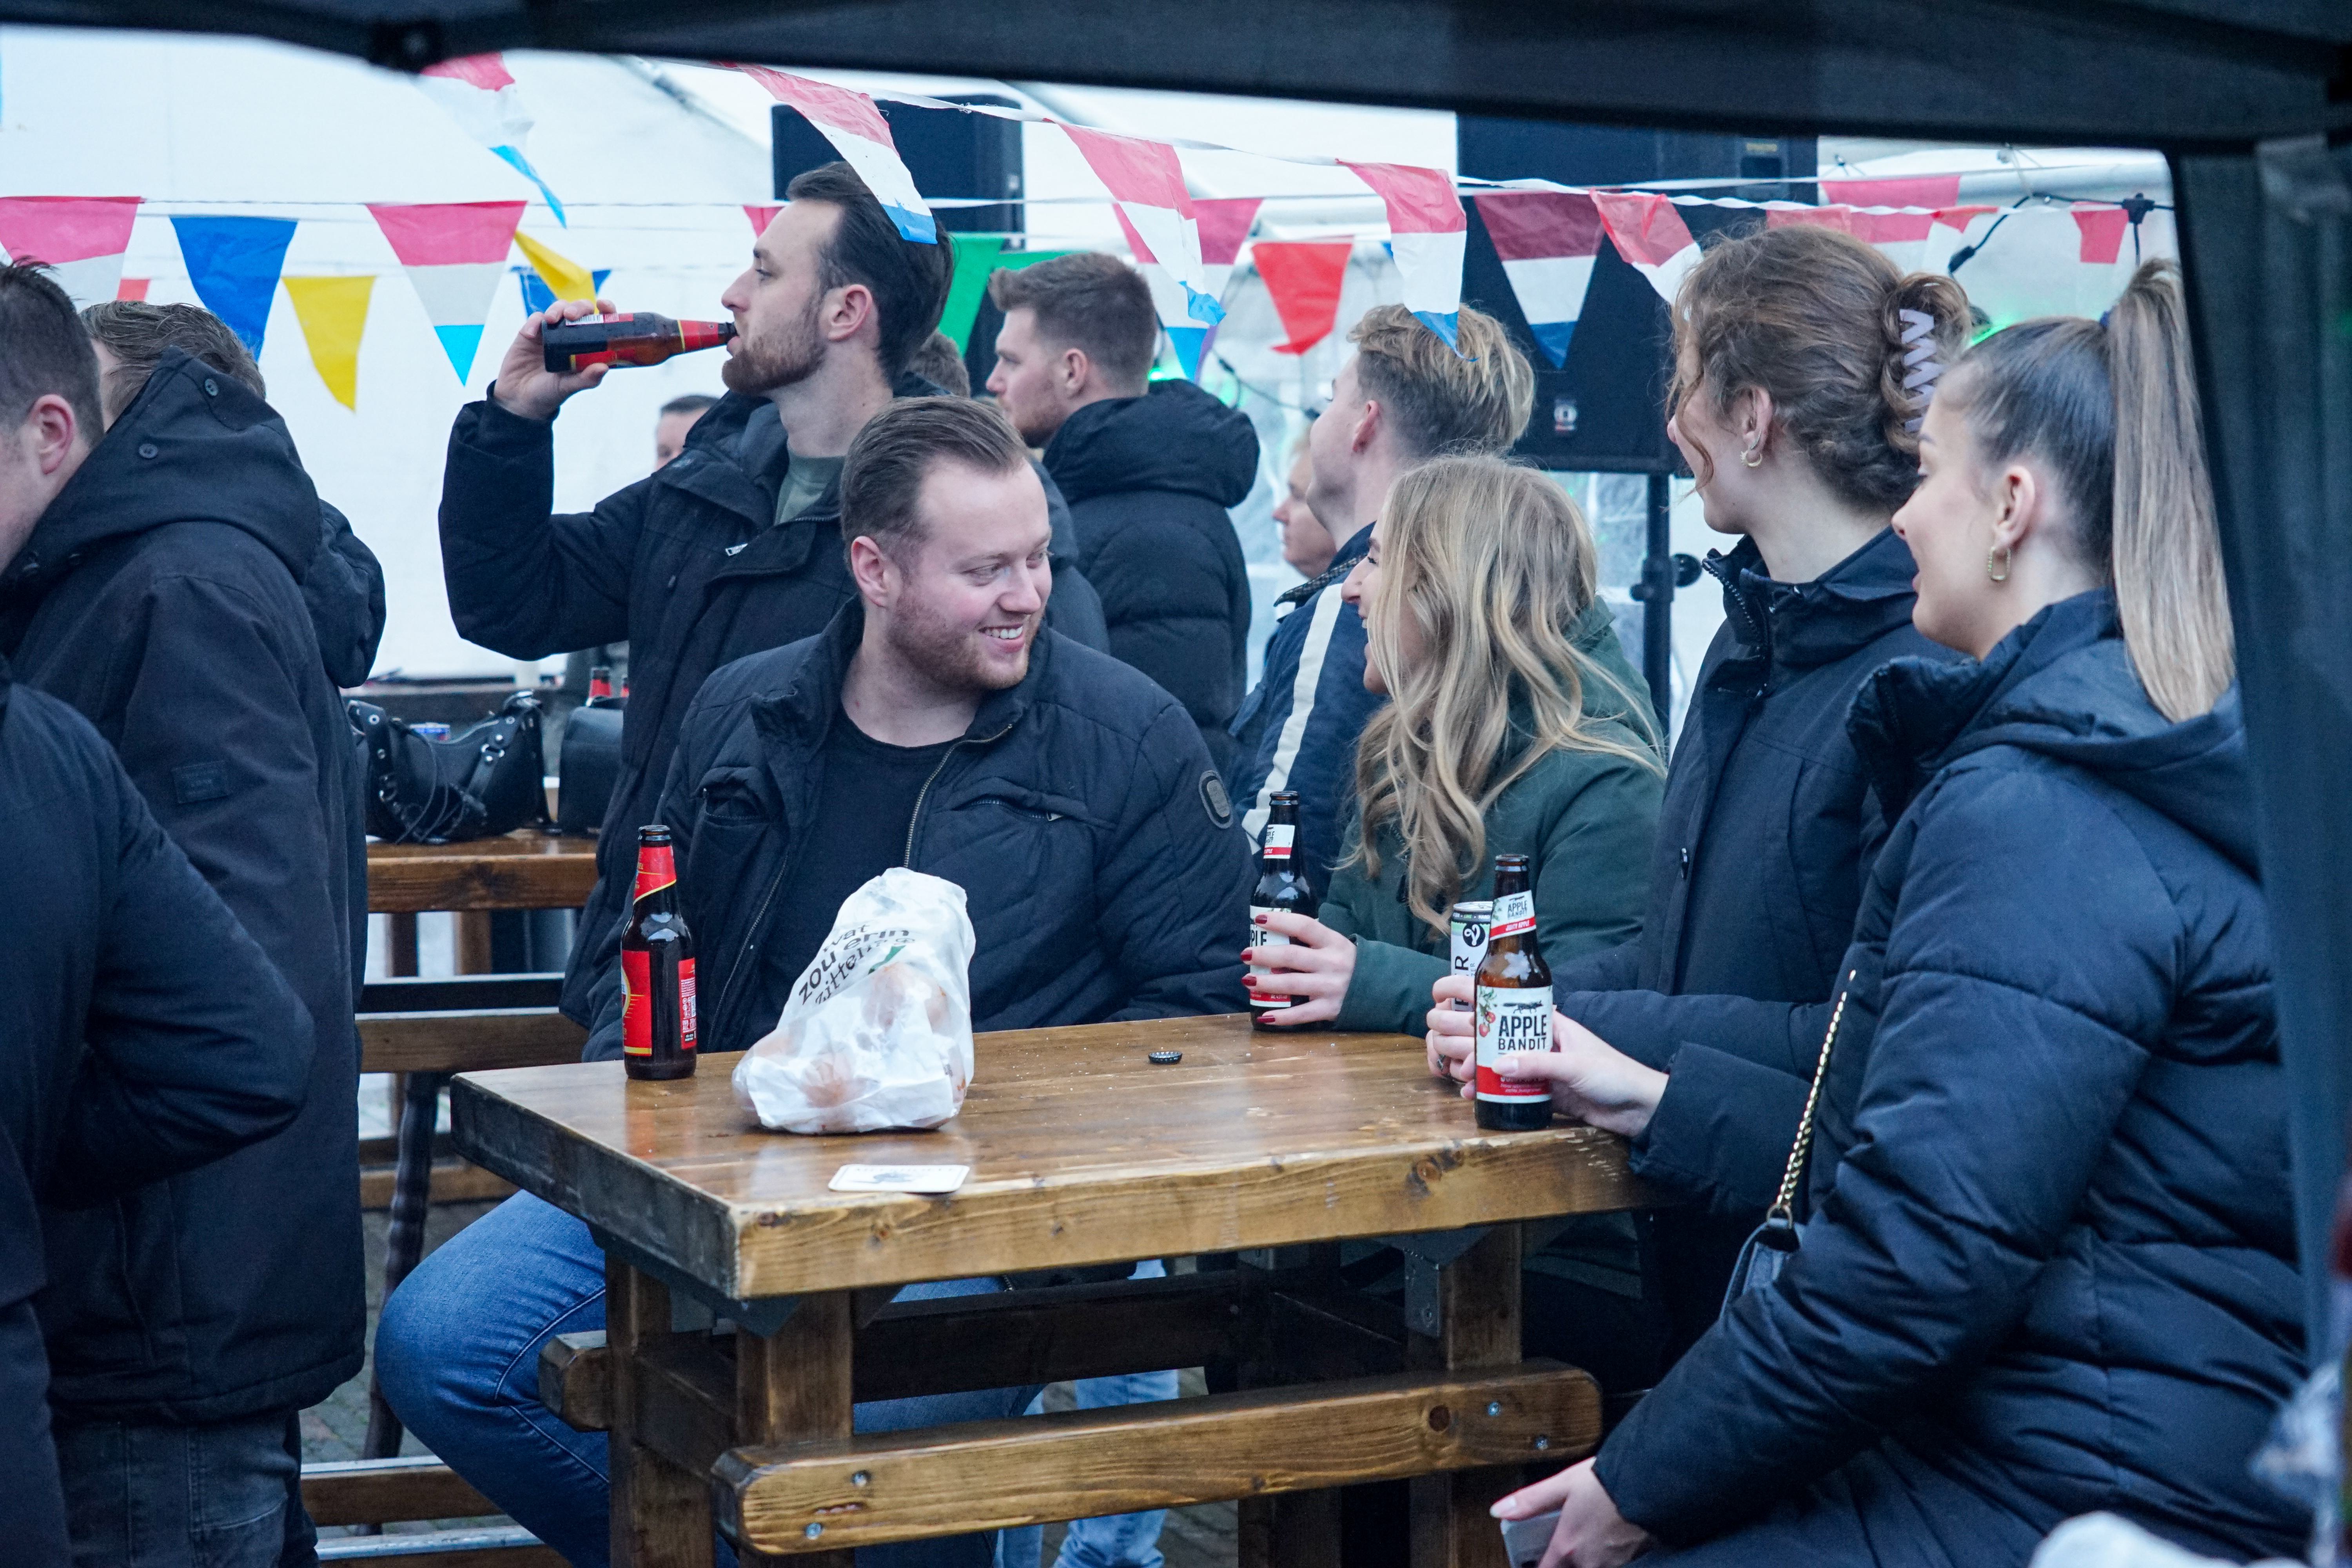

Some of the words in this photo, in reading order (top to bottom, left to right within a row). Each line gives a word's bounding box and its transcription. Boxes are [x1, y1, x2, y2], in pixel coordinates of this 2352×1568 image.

[1508, 900, 1527, 912] APPLE
[1507, 909, 1527, 918] BANDIT
[799, 951, 836, 1005] zou
[1499, 1014, 1547, 1037] APPLE
[1498, 1037, 1547, 1051] BANDIT
